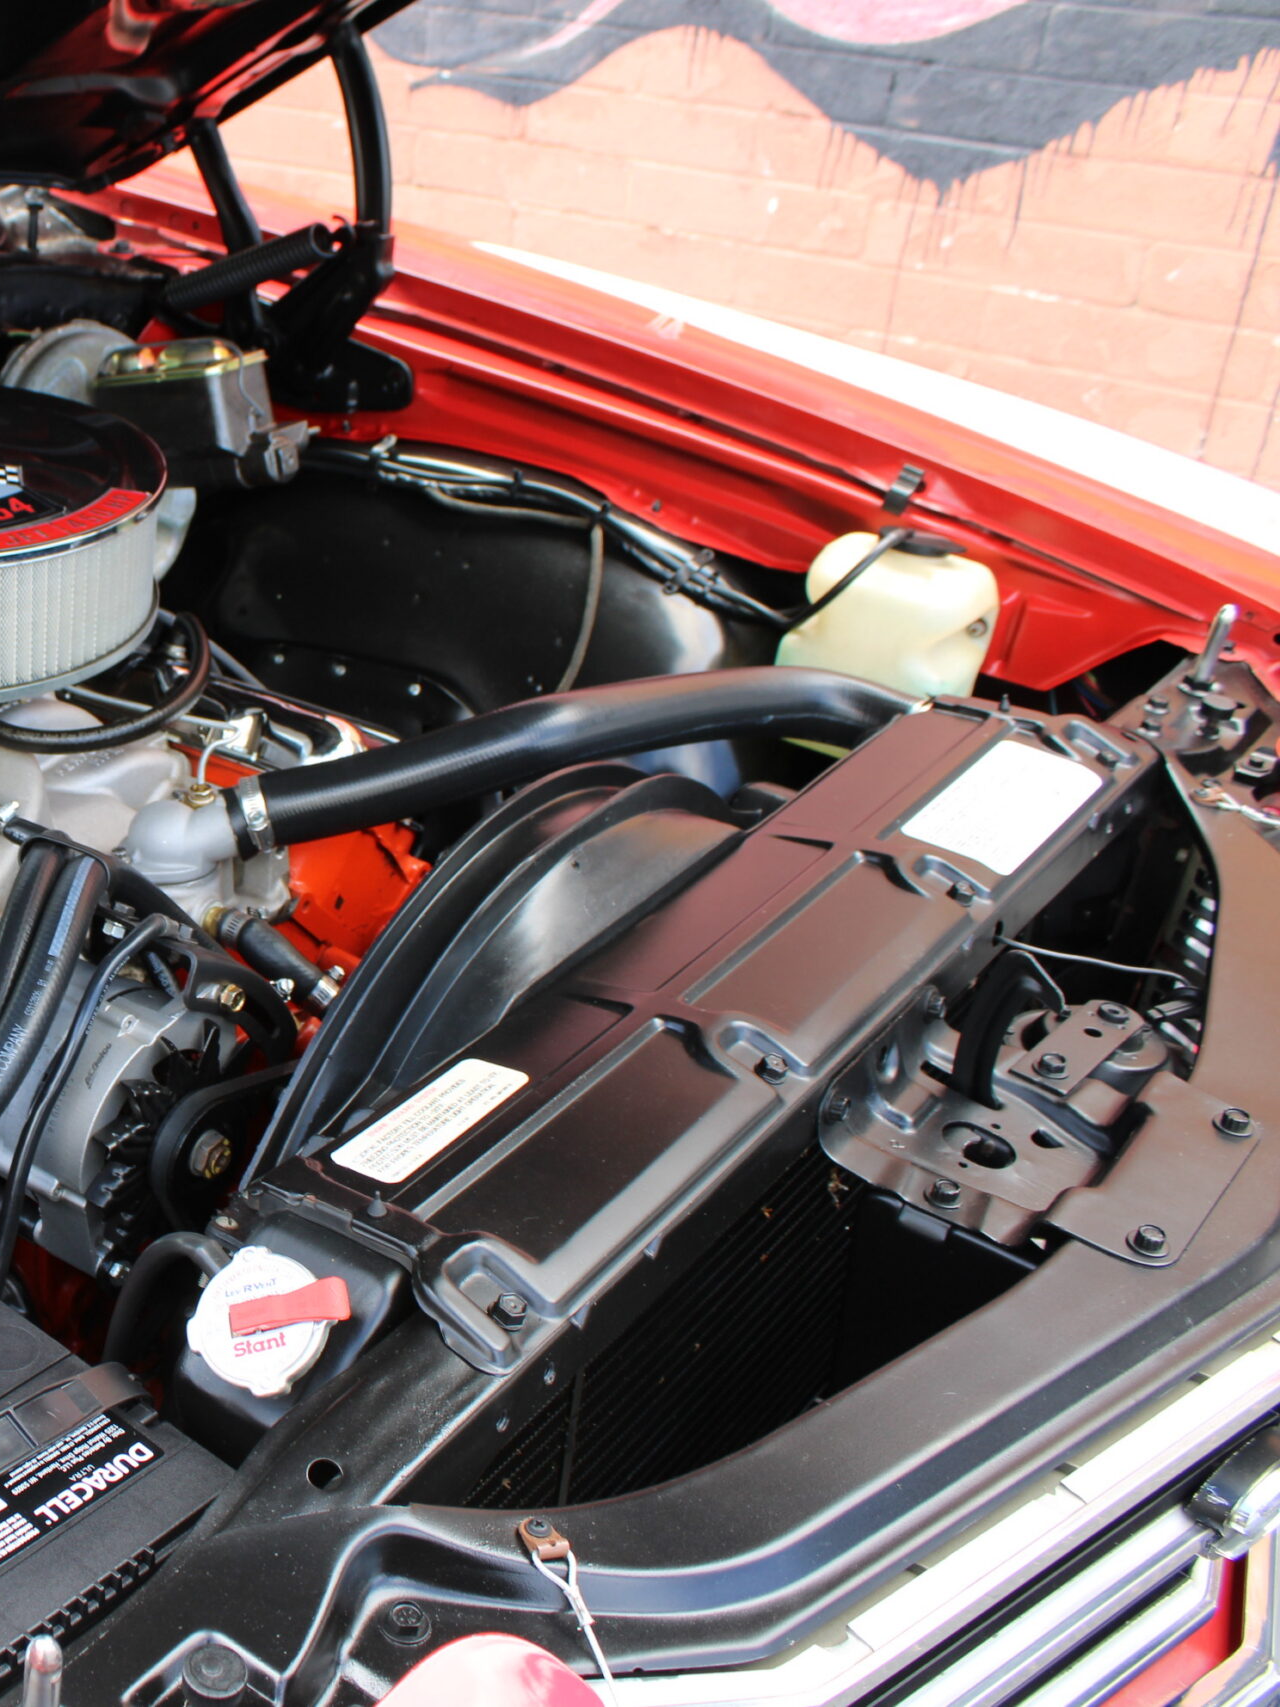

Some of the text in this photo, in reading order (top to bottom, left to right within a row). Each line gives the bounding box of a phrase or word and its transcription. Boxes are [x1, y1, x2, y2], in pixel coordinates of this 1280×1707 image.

[234, 1332, 286, 1358] Stant
[34, 1441, 154, 1523] DURACELL
[68, 1463, 96, 1482] ULTRA
